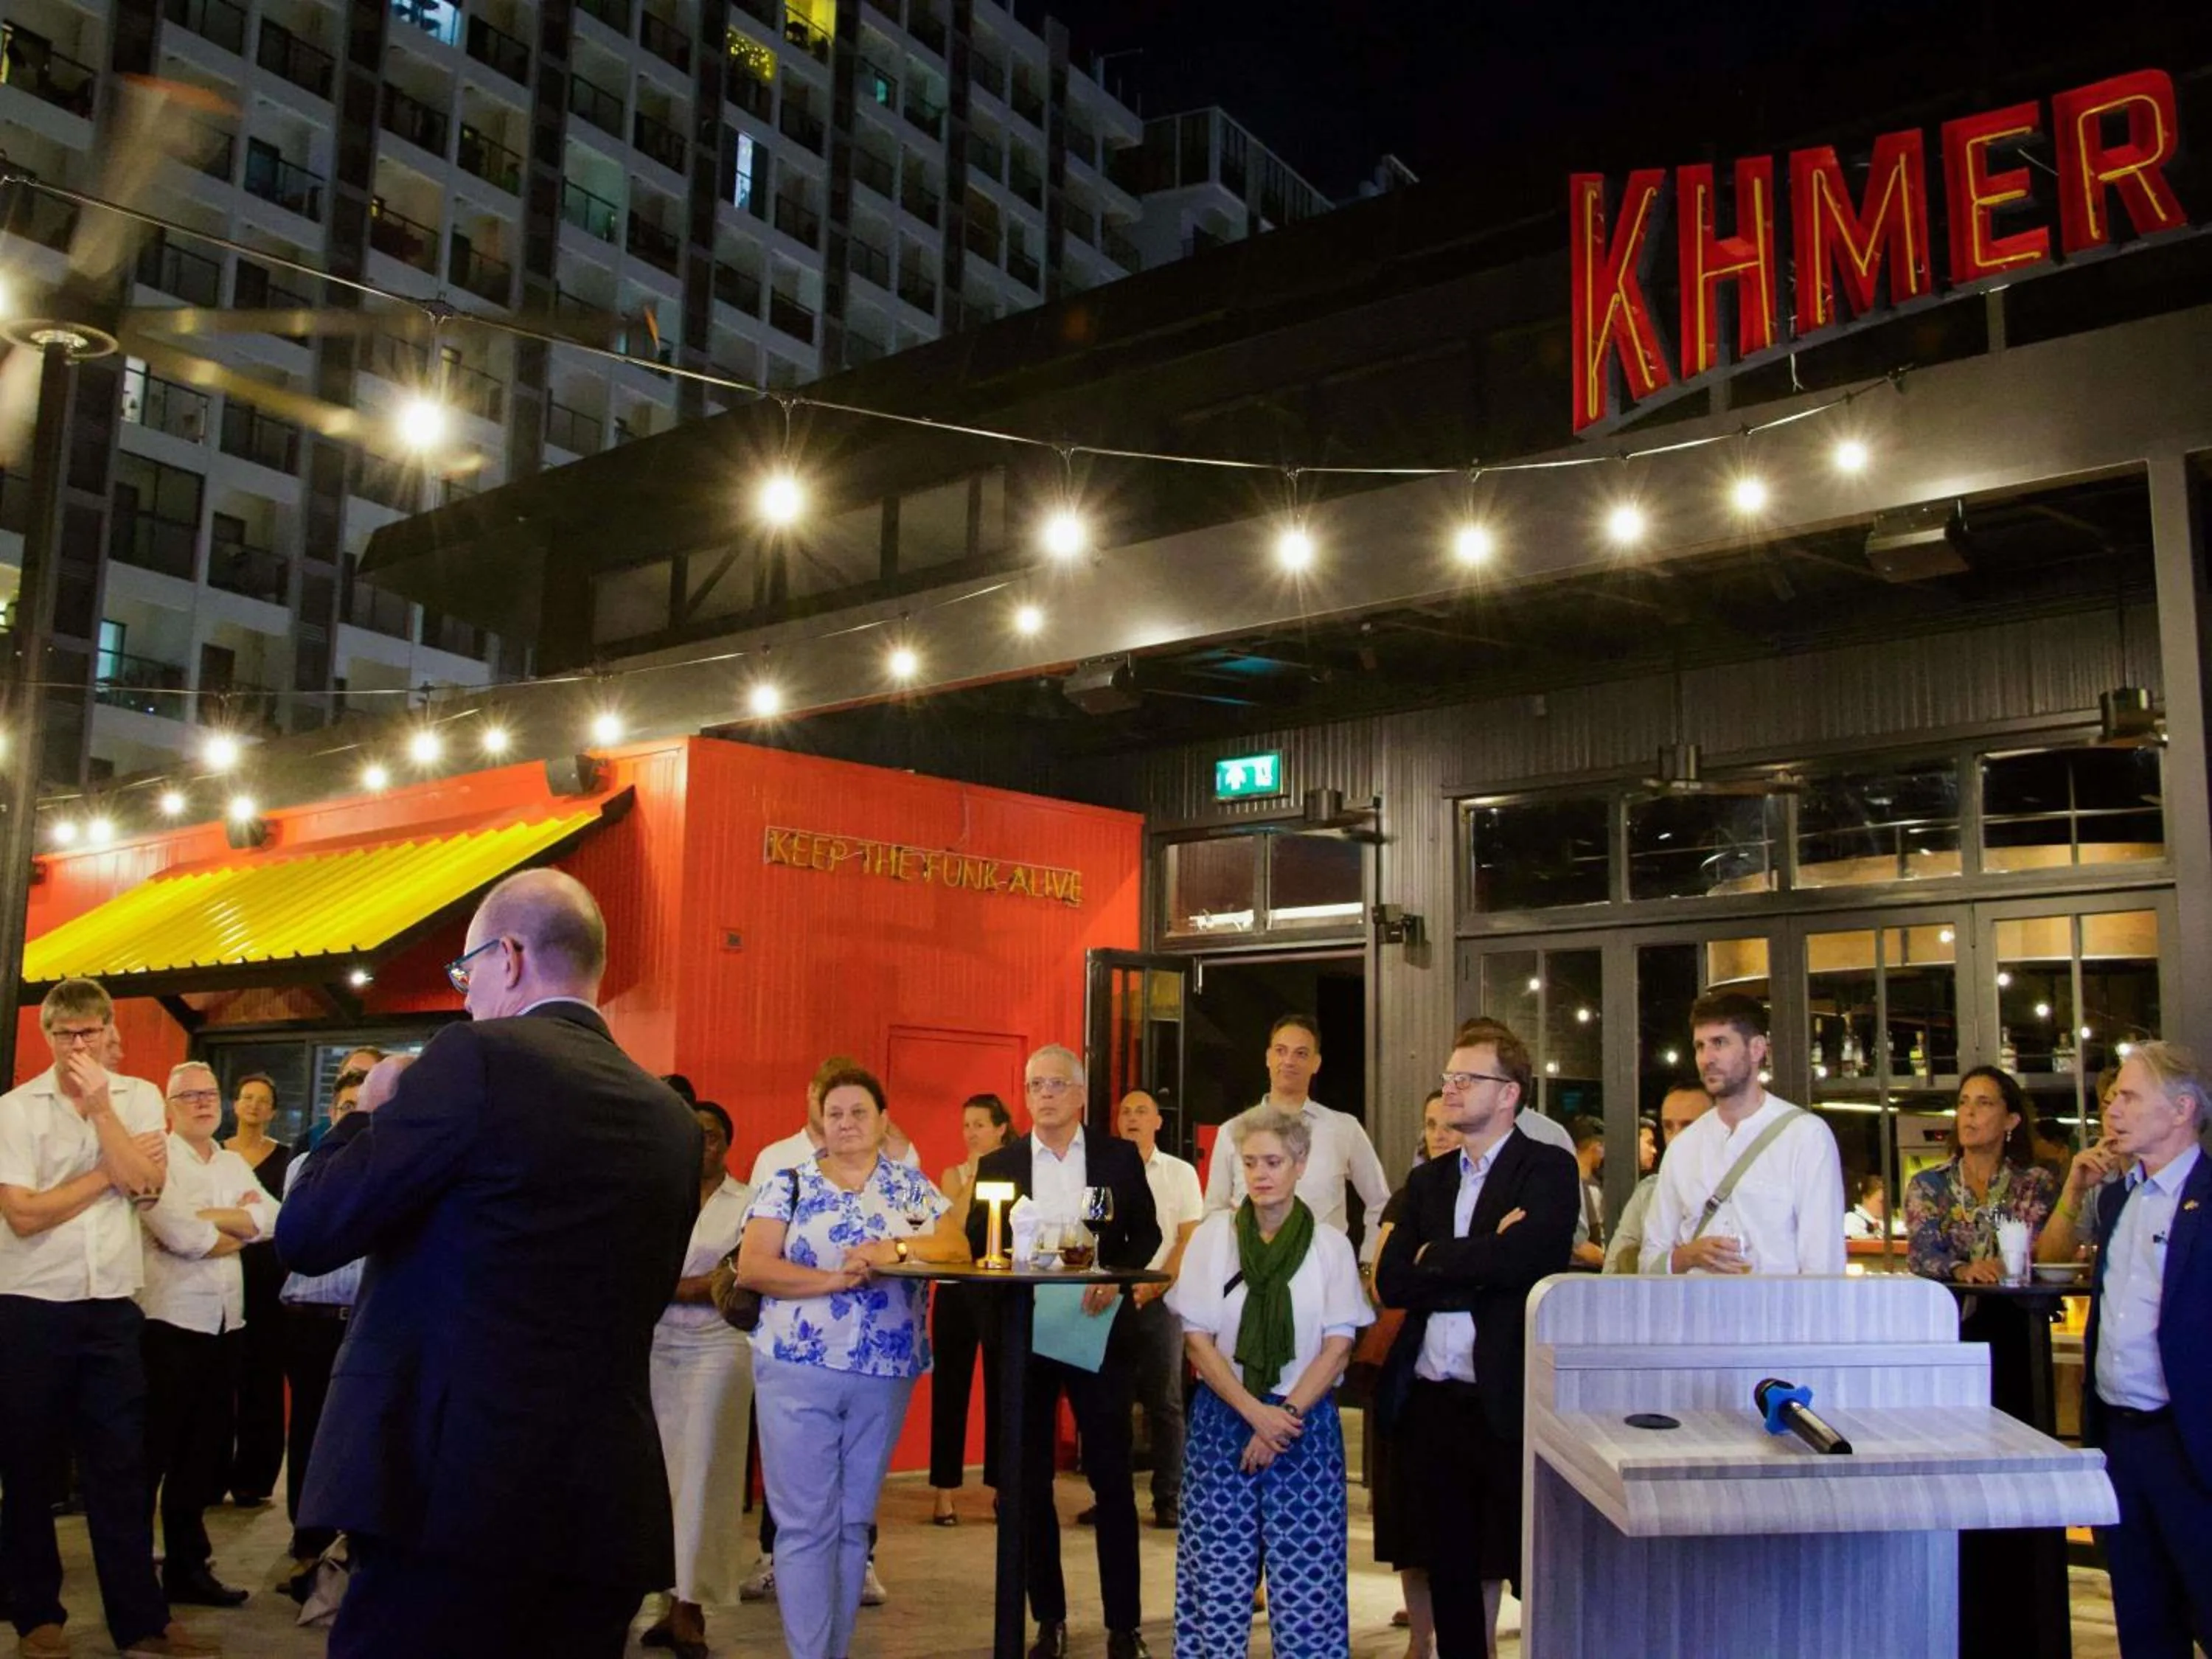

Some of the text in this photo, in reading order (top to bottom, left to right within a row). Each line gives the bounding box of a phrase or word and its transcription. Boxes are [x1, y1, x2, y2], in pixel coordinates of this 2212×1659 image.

[1570, 69, 2187, 435] KHMER
[771, 830, 1082, 903] KEEP THE FUNK ALIVE
